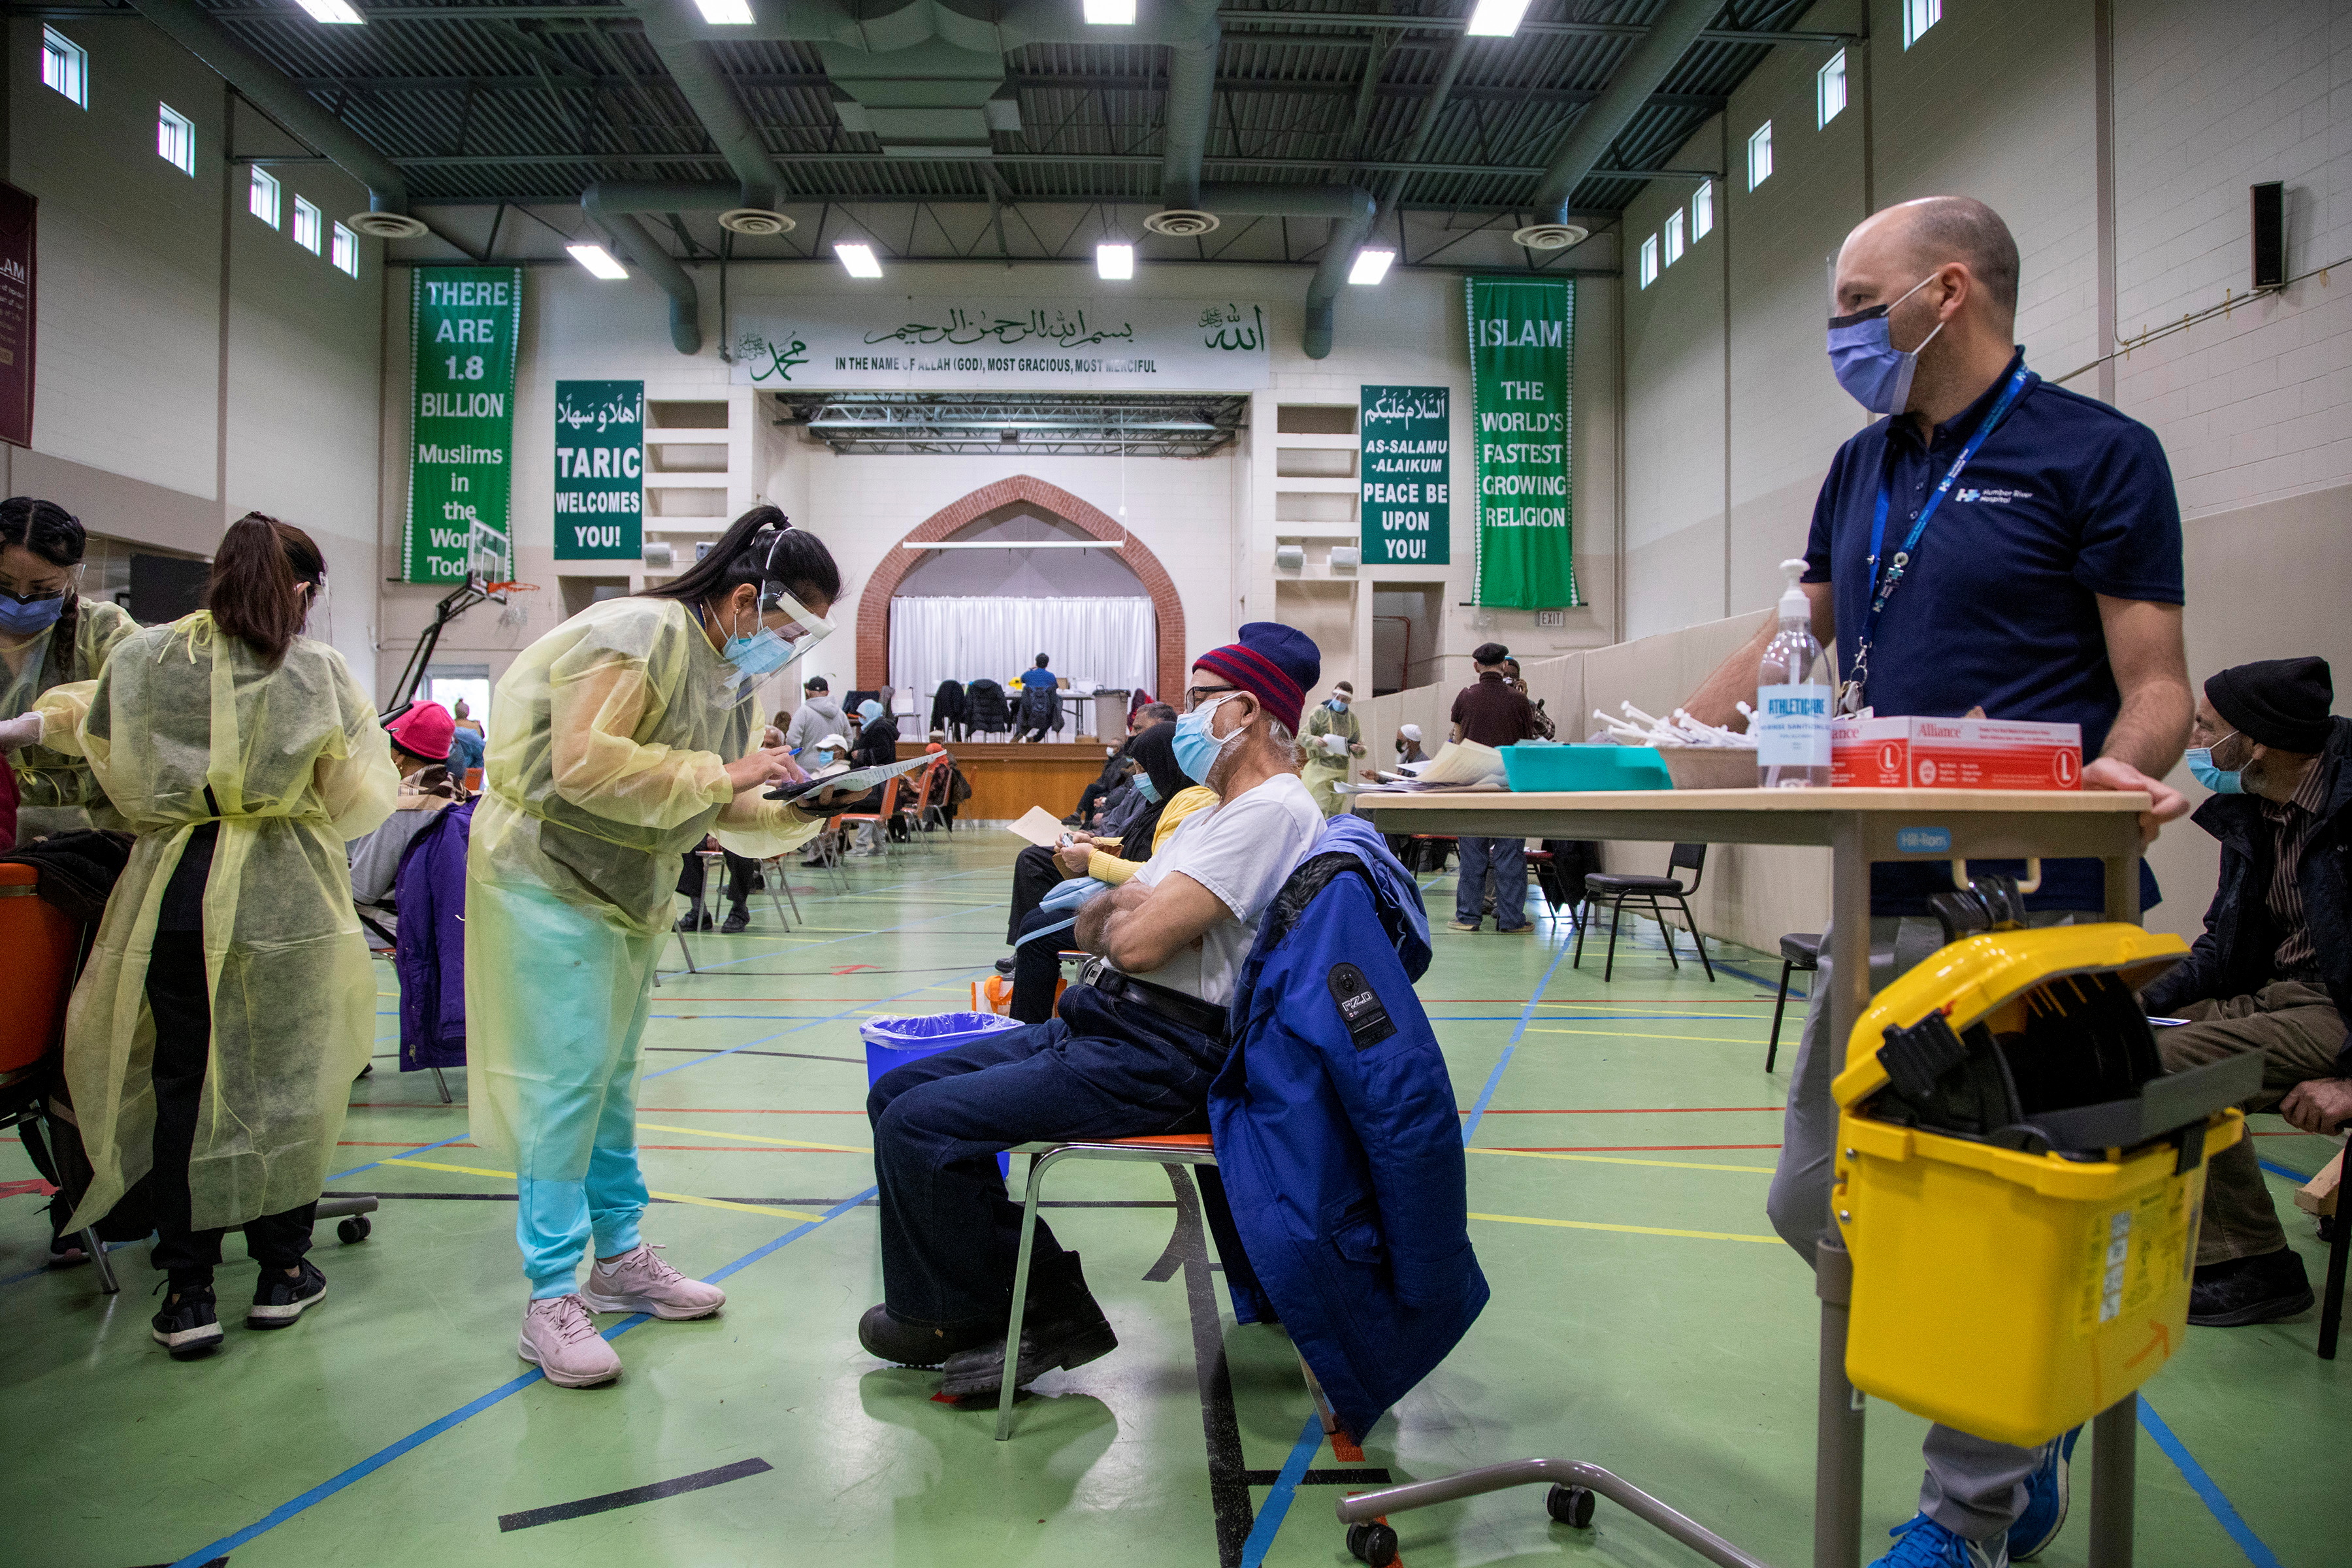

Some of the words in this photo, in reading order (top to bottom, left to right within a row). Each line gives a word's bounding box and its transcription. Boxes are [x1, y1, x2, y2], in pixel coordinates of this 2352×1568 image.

[425, 282, 508, 306] THERE
[434, 319, 494, 343] ARE
[1479, 318, 1563, 348] ISLAM
[445, 355, 484, 380] 1.8
[835, 357, 845, 370] IN
[849, 357, 868, 370] THE
[871, 357, 899, 370] NAME
[918, 358, 950, 371] ALLAH
[953, 358, 985, 374] (GOD),
[987, 358, 1015, 371] MOST
[1018, 358, 1073, 374] GRACIOUS,
[1075, 359, 1103, 372] MOST
[1106, 359, 1156, 373] MERCIFUL
[1501, 381, 1544, 400] THE
[421, 393, 504, 417] BILLION
[1480, 412, 1563, 432] WORLD'S
[418, 444, 503, 465] Muslims
[1365, 439, 1448, 453] AS-SALAMU
[1483, 443, 1563, 463] FASTEST
[557, 448, 640, 479] TARIC
[1372, 459, 1442, 472] -ALAIKUM
[451, 472, 469, 492] in
[1482, 475, 1567, 495] GROWING
[555, 491, 640, 514] WELCOMES
[1364, 483, 1419, 502] PEACE
[1426, 484, 1448, 503] BE
[442, 500, 476, 520] the
[1486, 507, 1565, 527] RELIGION
[1382, 511, 1429, 531] UPON
[429, 528, 477, 548] Wor
[574, 525, 621, 547] YOU!
[1385, 539, 1426, 559] YOU!
[427, 556, 471, 576] Tod
[1542, 612, 1561, 625] EXIT
[1918, 723, 1961, 738] Alliance
